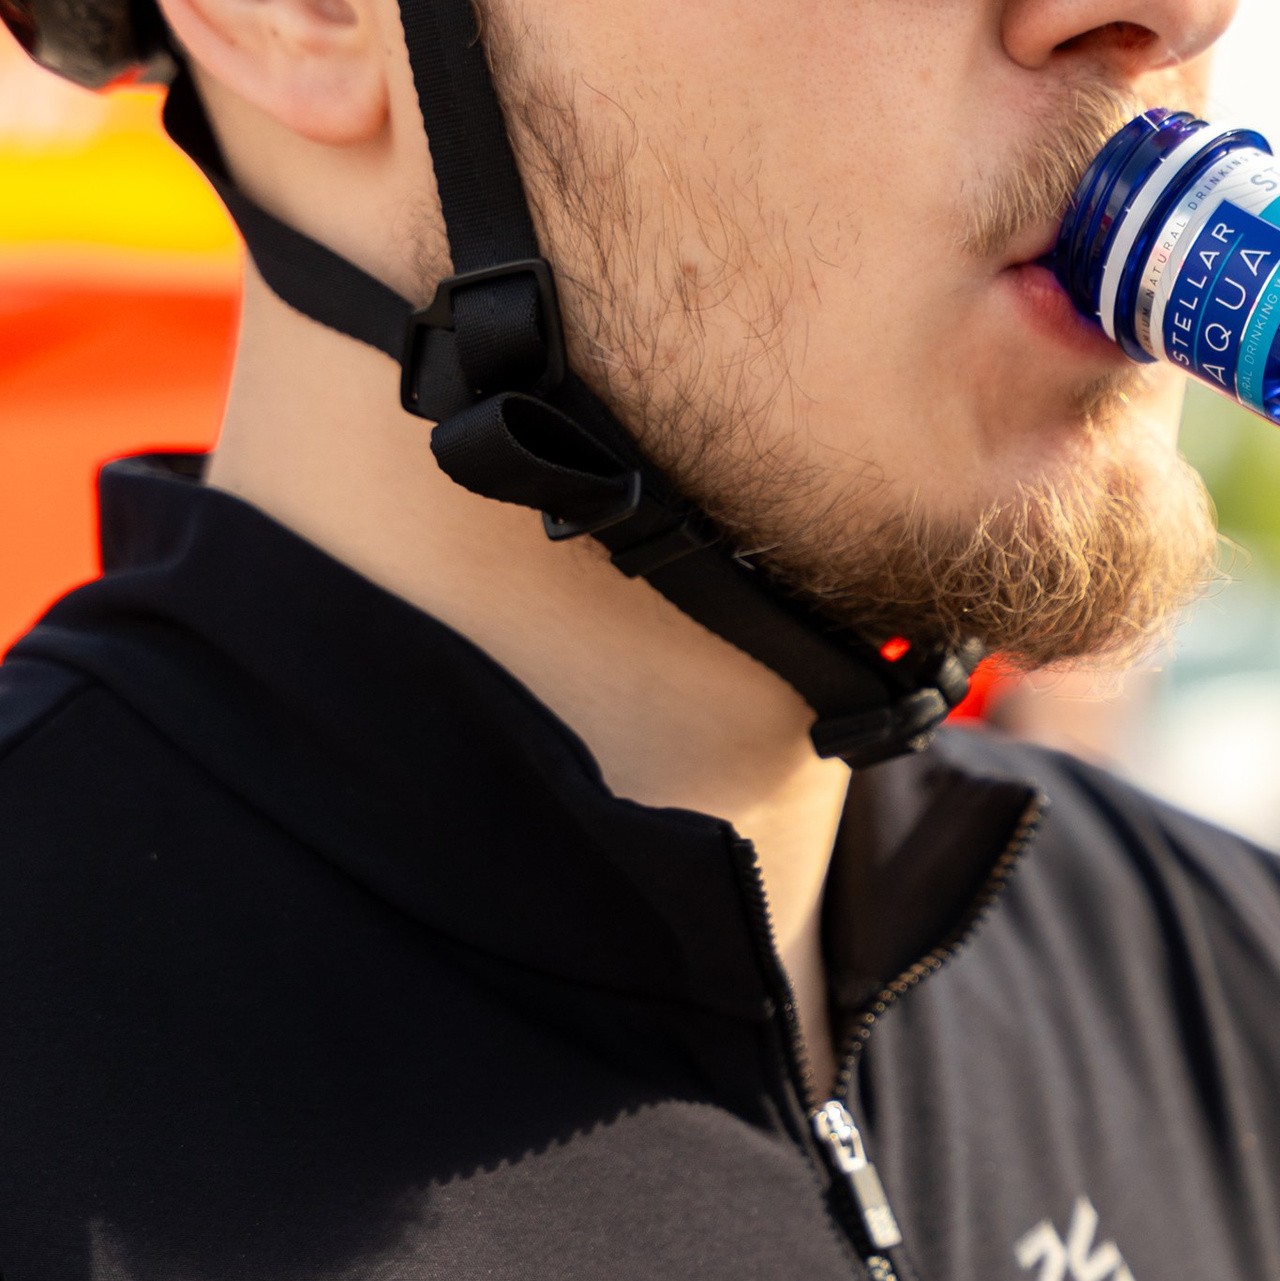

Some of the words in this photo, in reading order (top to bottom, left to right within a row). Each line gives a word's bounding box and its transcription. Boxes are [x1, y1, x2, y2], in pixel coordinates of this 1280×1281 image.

[1146, 221, 1188, 300] NATURAL
[1172, 222, 1235, 366] STELLAR
[1202, 246, 1272, 387] AQUA
[1245, 293, 1279, 365] DRINKING
